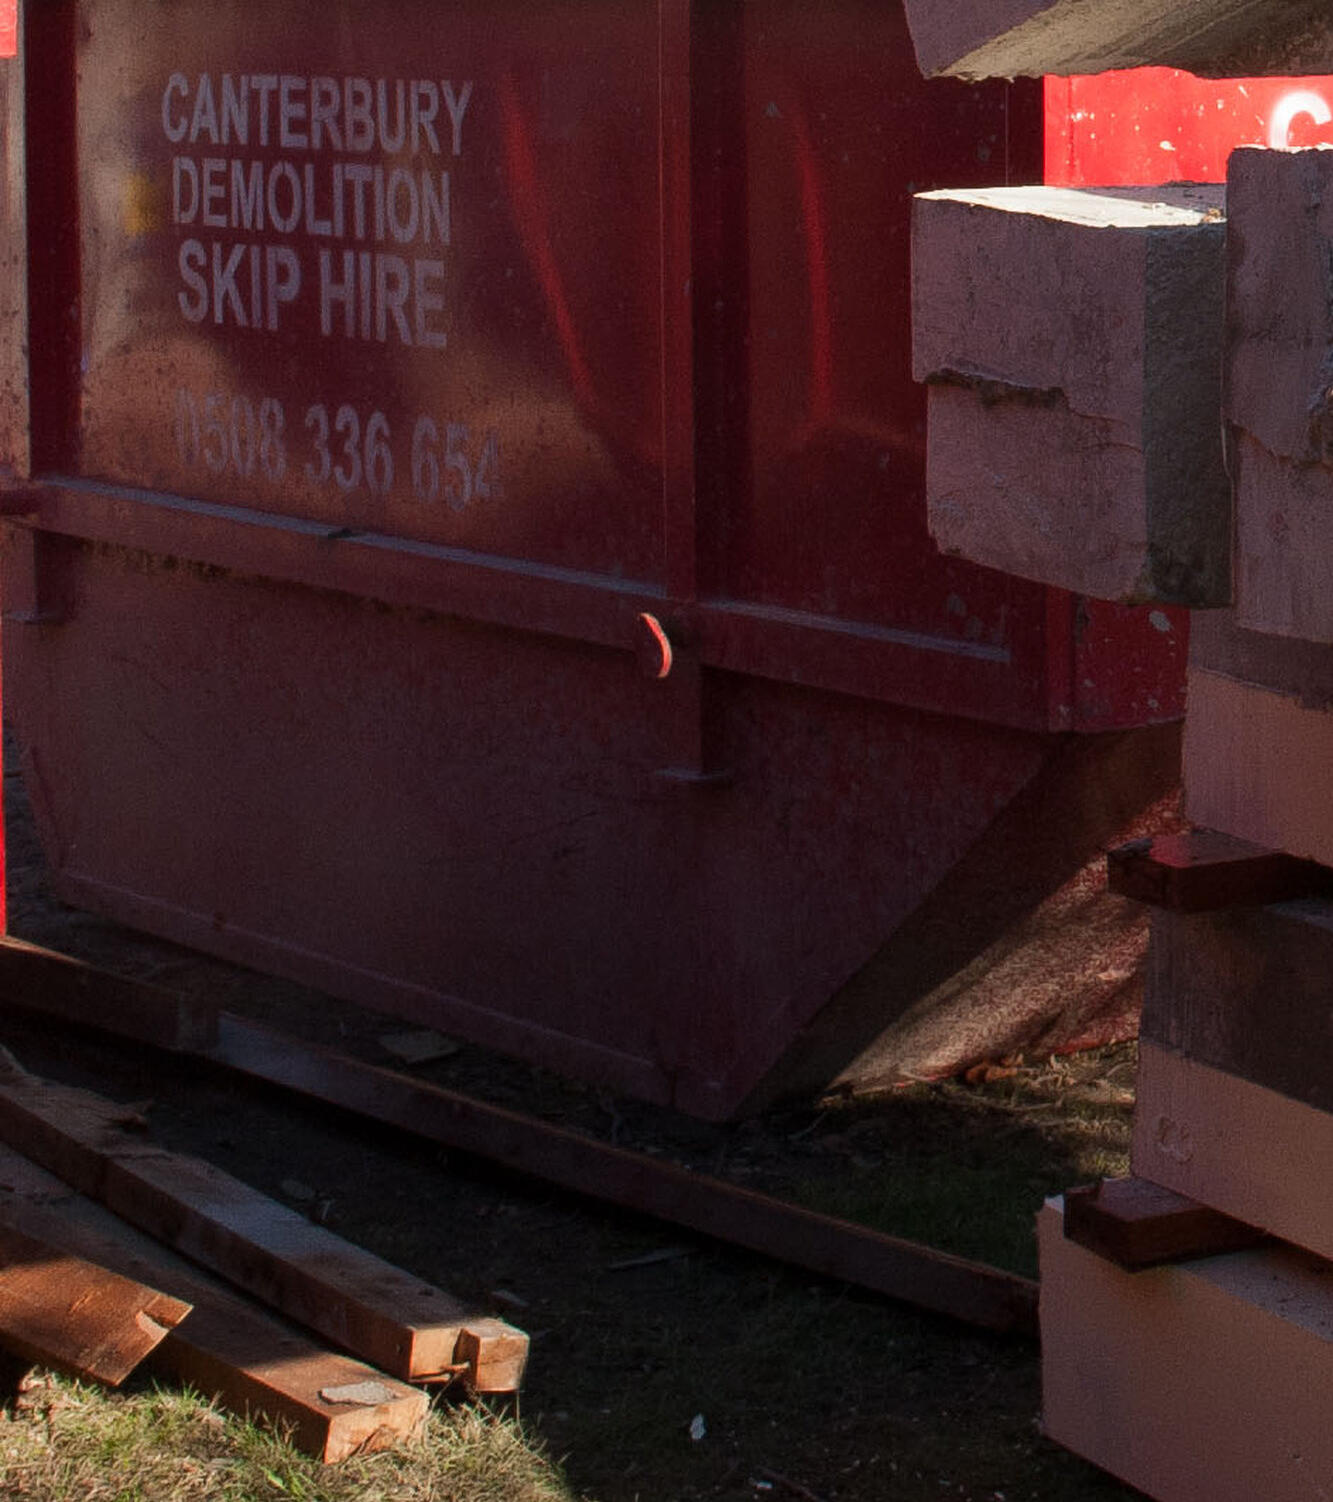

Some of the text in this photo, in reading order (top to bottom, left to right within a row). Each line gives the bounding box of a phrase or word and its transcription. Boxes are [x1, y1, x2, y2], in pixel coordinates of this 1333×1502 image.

[161, 72, 473, 156] CANTERBURY
[172, 156, 450, 245] DEMOLITION
[178, 239, 448, 348] SKIP HIRE
[175, 387, 500, 512] 0508 336 654
